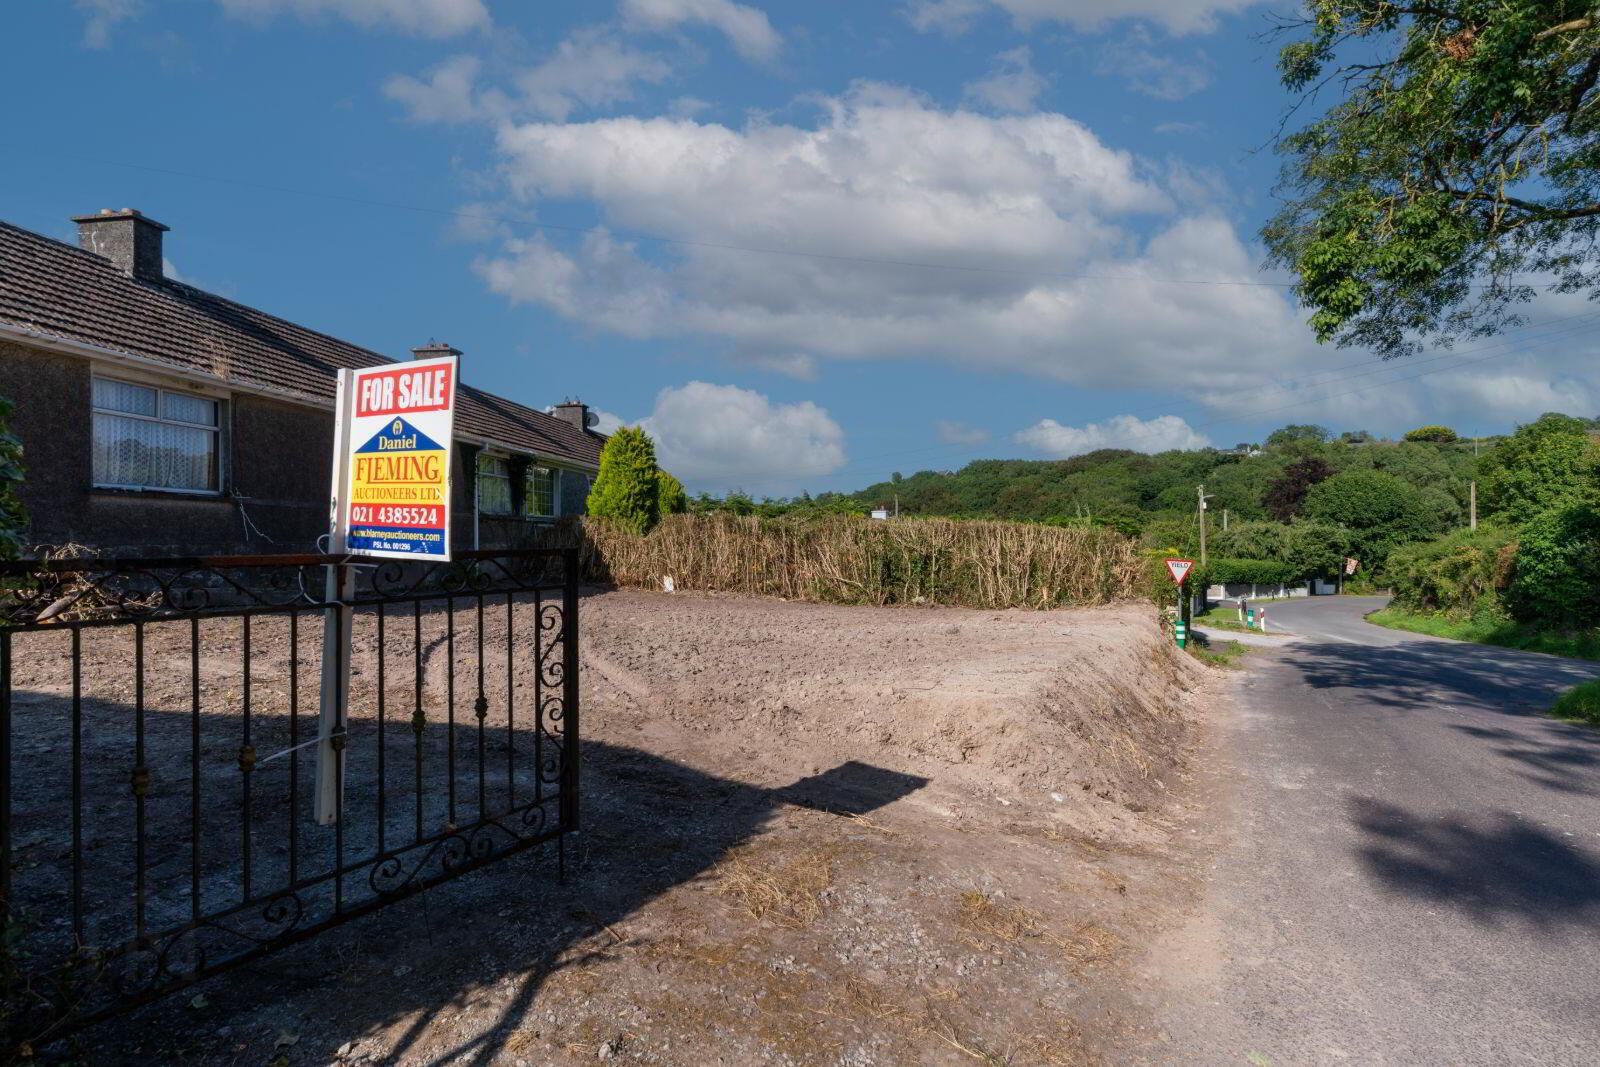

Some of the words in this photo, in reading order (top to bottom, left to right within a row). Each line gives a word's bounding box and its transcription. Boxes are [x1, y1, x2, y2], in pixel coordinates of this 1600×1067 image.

[361, 376, 394, 412] FOR
[398, 369, 445, 409] SALE
[378, 434, 416, 450] Daniel
[356, 455, 441, 484] FLEMING
[354, 487, 417, 500] AUCTIONEERS
[352, 506, 373, 522] 021
[378, 507, 437, 525] 4385524
